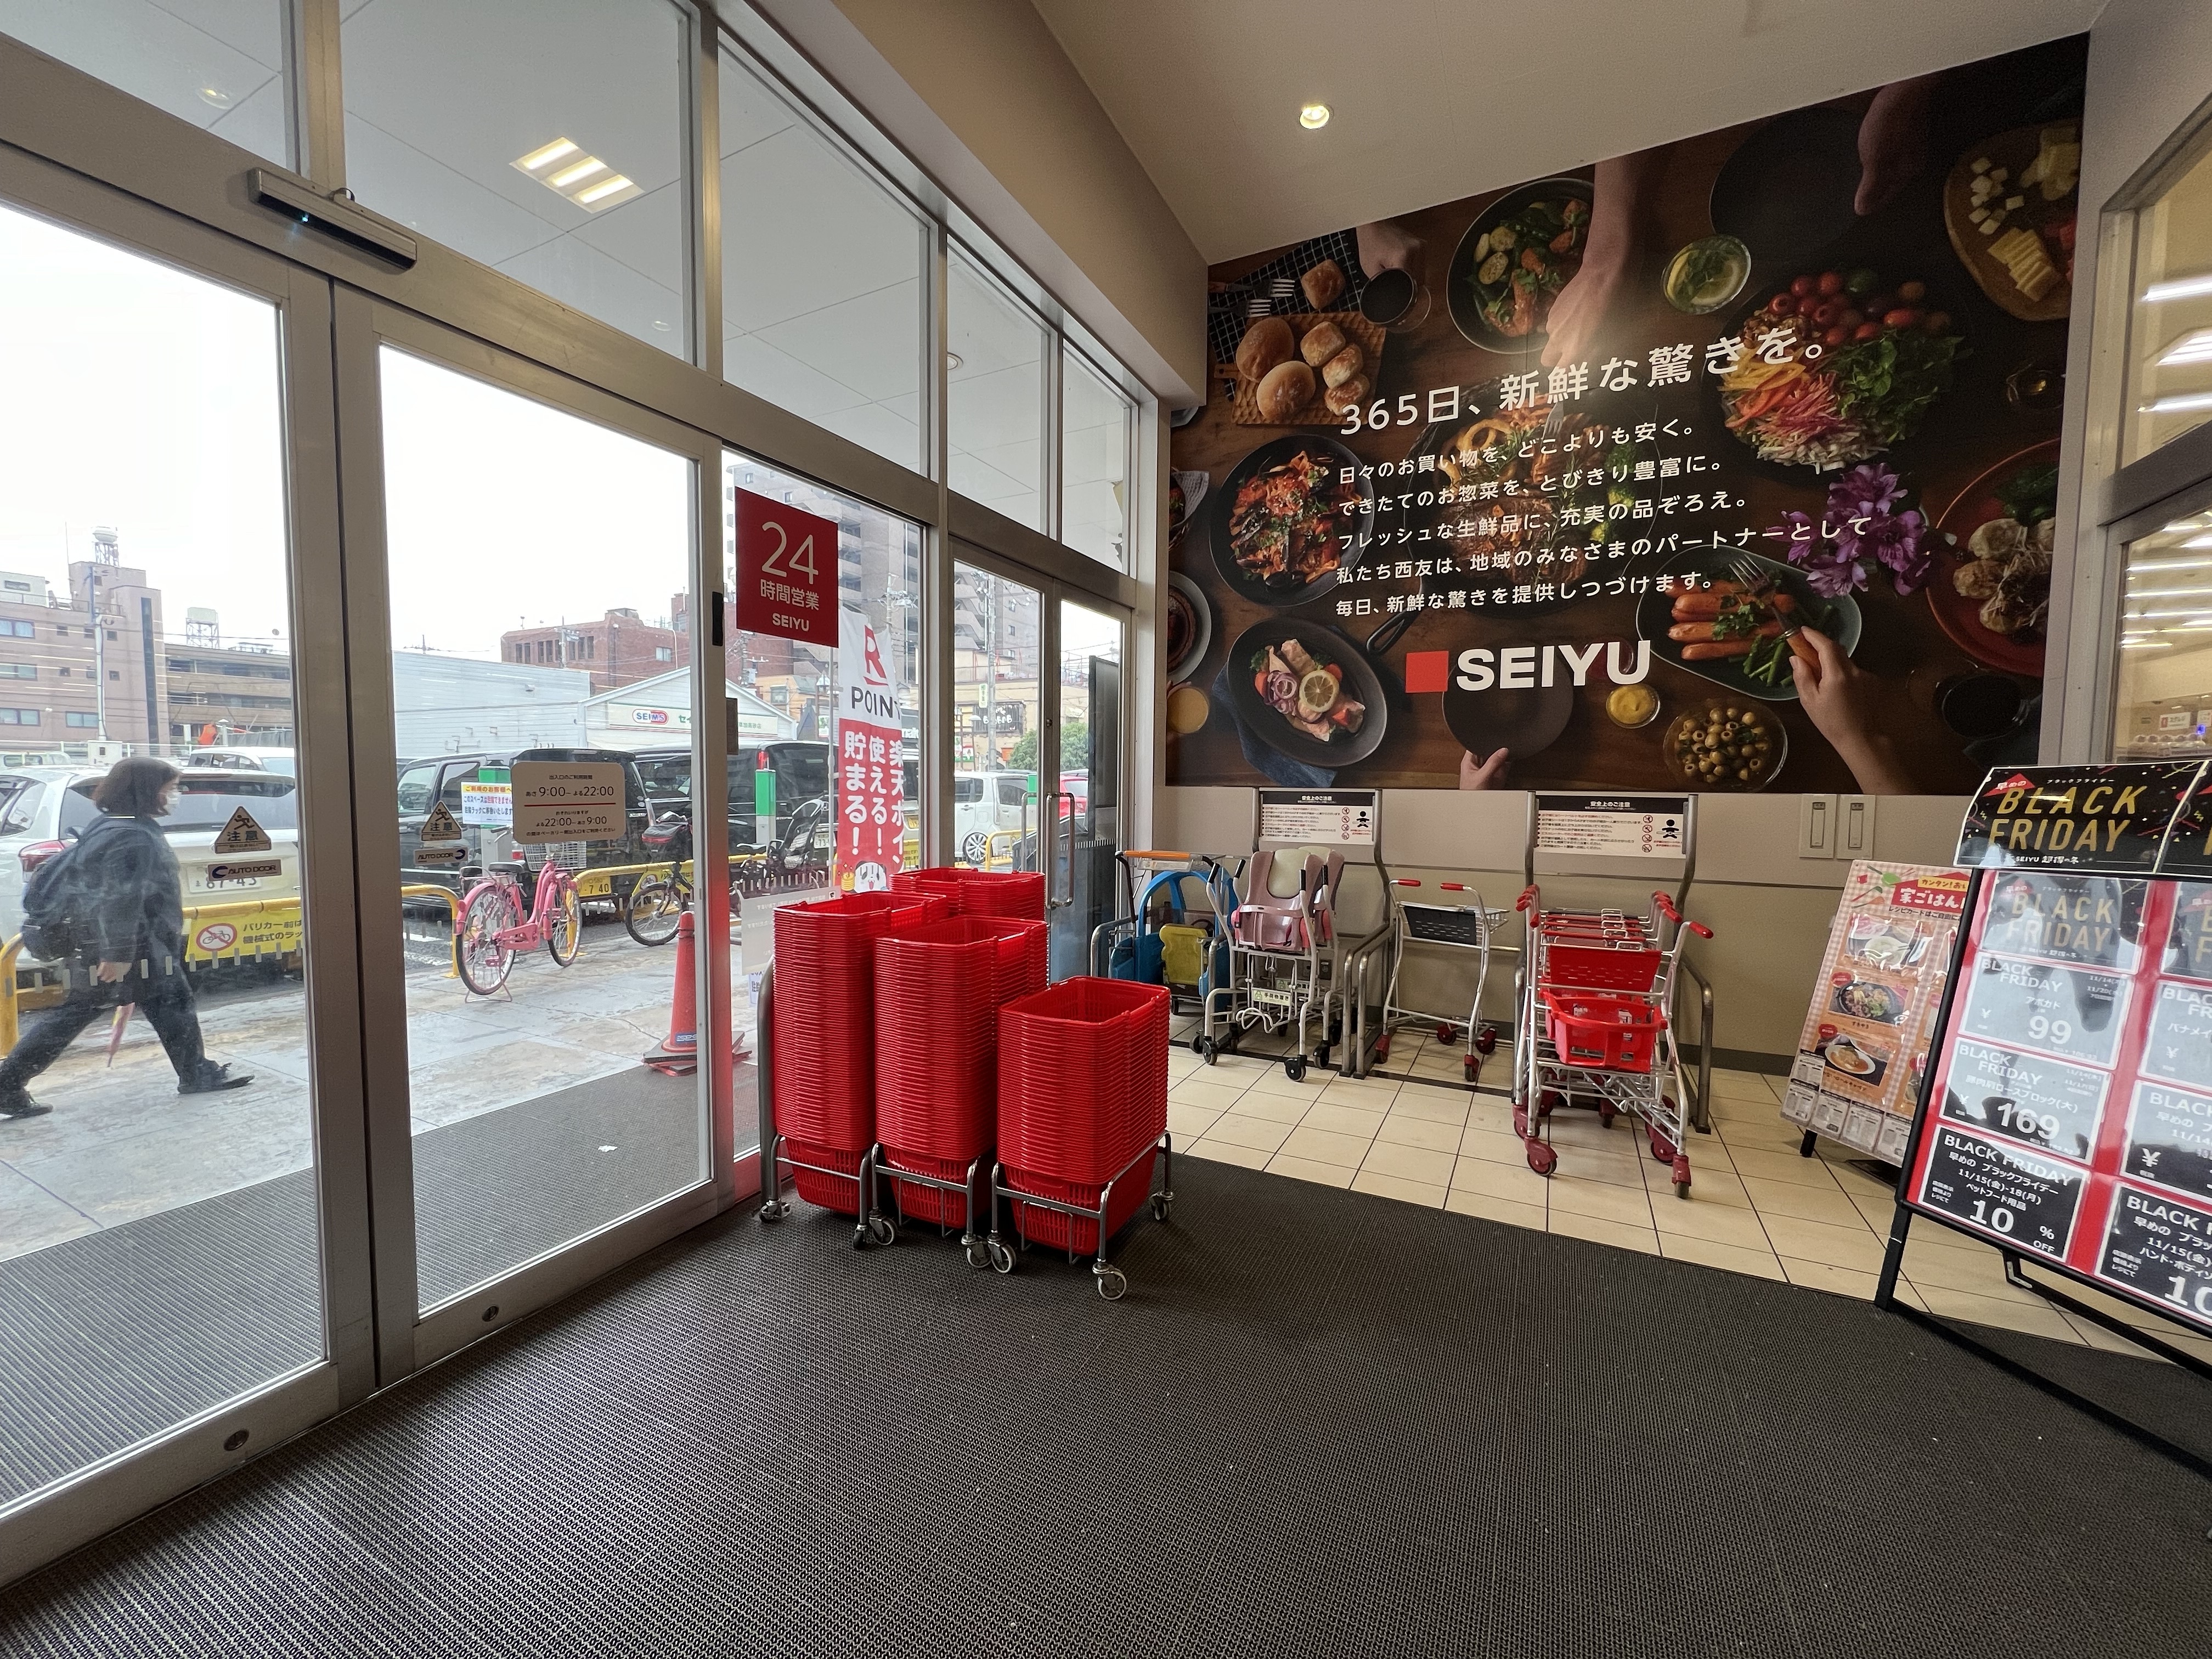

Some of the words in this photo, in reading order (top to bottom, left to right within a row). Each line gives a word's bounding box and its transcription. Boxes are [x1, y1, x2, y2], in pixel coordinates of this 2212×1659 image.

[1340, 327, 1825, 436] 365日、新鮮な驚きを。
[1339, 418, 1694, 486] 日々のお買い物を、どこよりも安く。
[1339, 455, 1722, 517] できたてのお惣菜を、とびきり豊富に。
[1339, 493, 1746, 550] フレッシュな生鮮品に、充実の品ぞろえ。
[761, 521, 819, 585] 24
[1336, 515, 1871, 585] 私たち西友は、地域のみなさまのパートナーとして
[760, 580, 819, 611] 時間営業
[1336, 572, 1712, 617] 毎日、新鮮な驚きを提供しつづけます。
[772, 613, 809, 632] SEIYU
[1456, 640, 1651, 691] SEIYU
[636, 713, 664, 721] SEIMS
[1997, 786, 2148, 815] BLACK
[1988, 819, 2131, 852] FRIDAY
[2012, 891, 2115, 924] BLACK
[2007, 918, 2111, 952] FRIDAY
[1981, 958, 2033, 977] BLACK
[2000, 973, 2063, 992] FRIDAY
[2028, 1015, 2072, 1045] 99
[1959, 1045, 2012, 1066] BLACK
[1978, 1060, 2042, 1085] FRIDAY
[1997, 1103, 2060, 1140] 169
[1944, 1135, 2000, 1162] BLACK
[2002, 1154, 2075, 1186] FRIDAY
[1949, 1152, 1976, 1167] 早めの
[2141, 1148, 2162, 1167] ¥
[1970, 1200, 2015, 1233] 10
[2126, 1195, 2200, 1231] BLACK
[2134, 1216, 2171, 1236] 早めの
[2033, 1240, 2055, 1253] OFF
[2039, 1226, 2055, 1240] %
